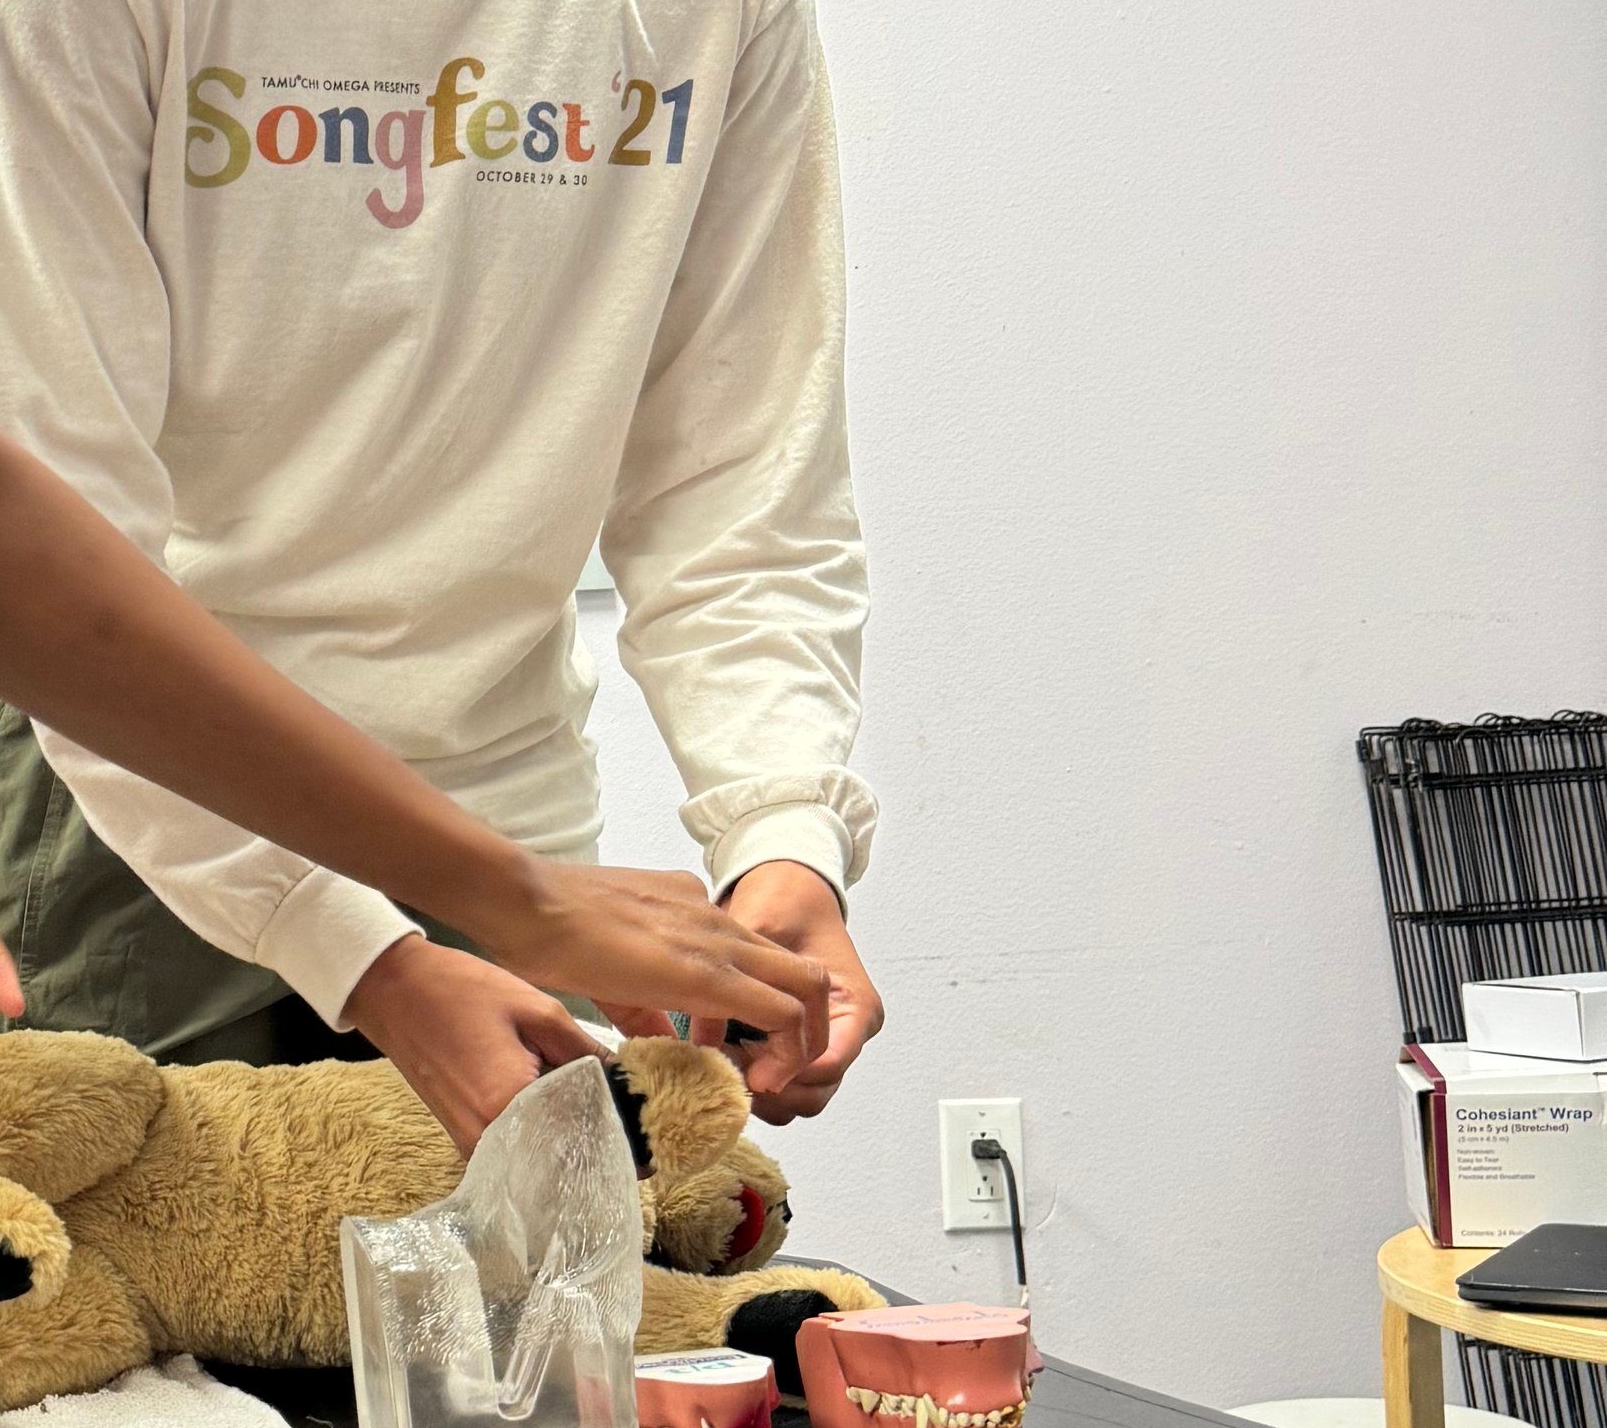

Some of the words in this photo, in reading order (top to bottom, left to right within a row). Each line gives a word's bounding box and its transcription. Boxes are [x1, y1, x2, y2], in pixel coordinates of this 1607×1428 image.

[323, 79, 370, 92] OMEGA
[374, 80, 420, 95] PRESENTS
[184, 57, 595, 229] Songfest
[476, 171, 536, 184] OCTOBER
[540, 173, 554, 185] 29
[559, 174, 567, 185] &
[574, 174, 588, 186] 30
[1550, 1107, 1593, 1122] Wrap
[1458, 1124, 1465, 1133] 2
[1467, 1124, 1477, 1133] in
[1486, 1124, 1493, 1133] 5
[1495, 1124, 1508, 1135] yd
[1511, 1123, 1569, 1135] (Stretched)
